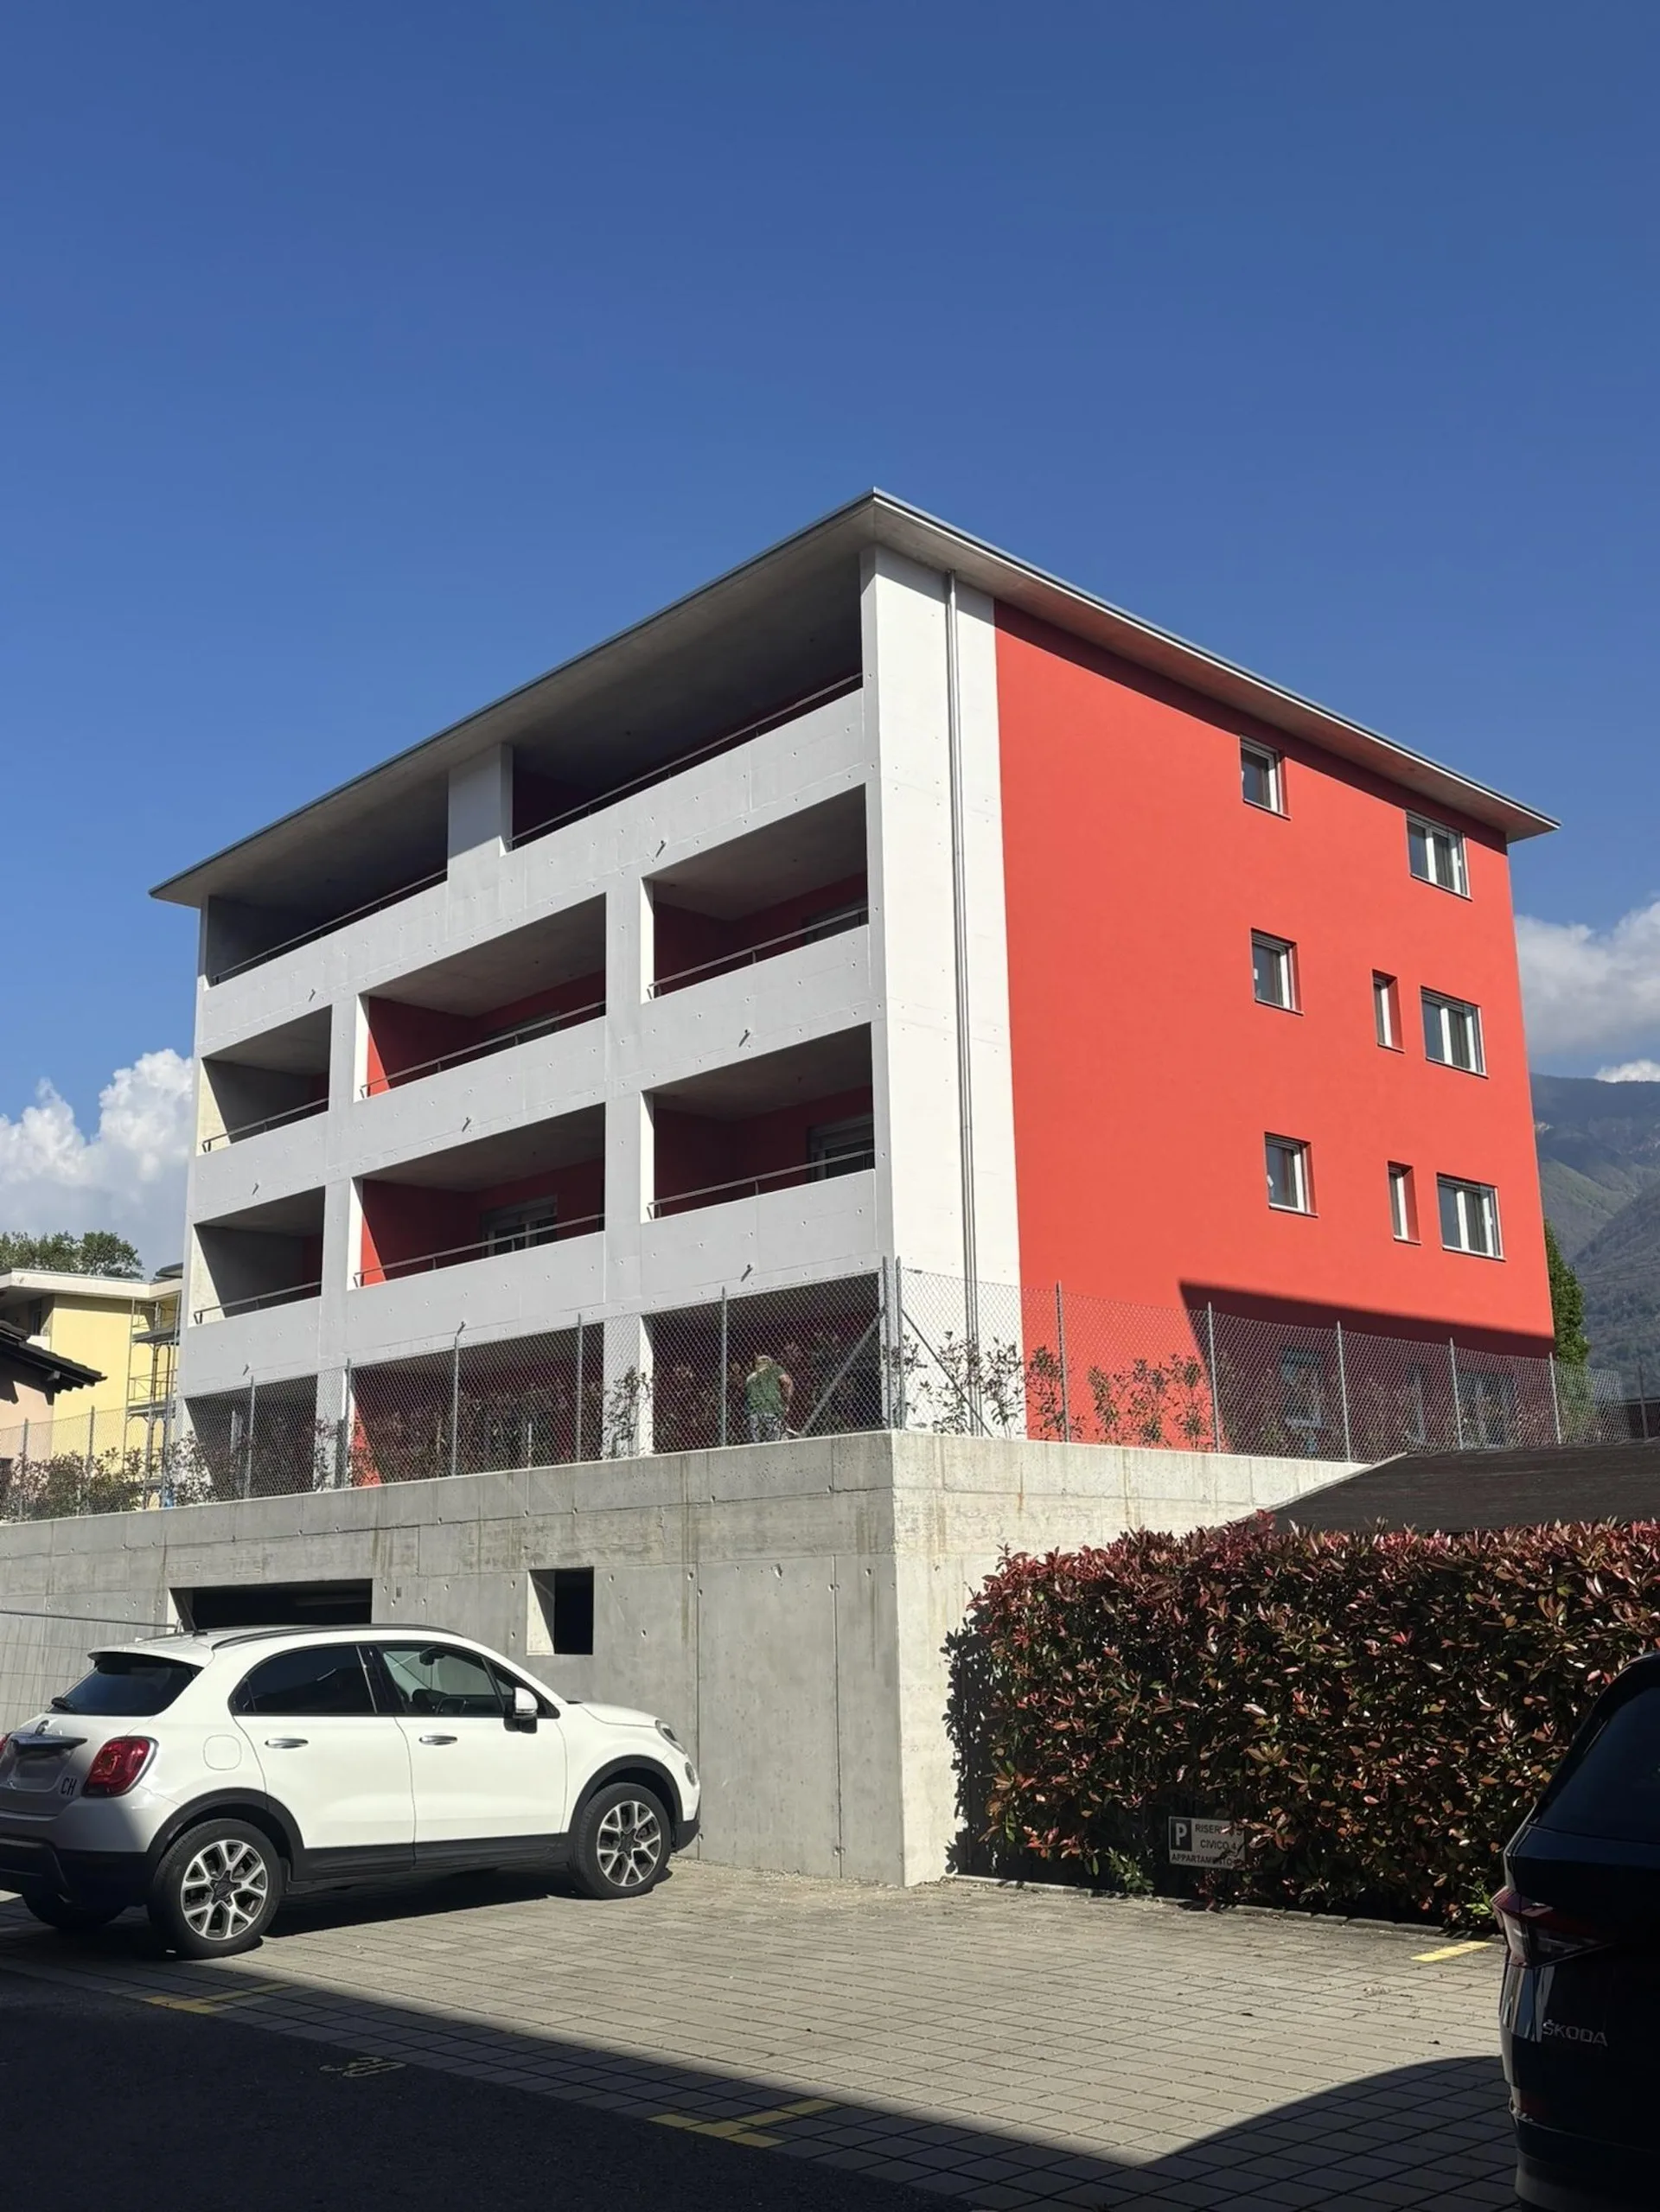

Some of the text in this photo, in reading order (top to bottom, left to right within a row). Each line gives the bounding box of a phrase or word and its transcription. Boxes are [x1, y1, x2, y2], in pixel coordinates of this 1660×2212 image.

[61, 1777, 77, 1795] CH
[1176, 1822, 1187, 1845] P
[1195, 1824, 1242, 1836] RISER
[1200, 1839, 1229, 1851] CIVICO
